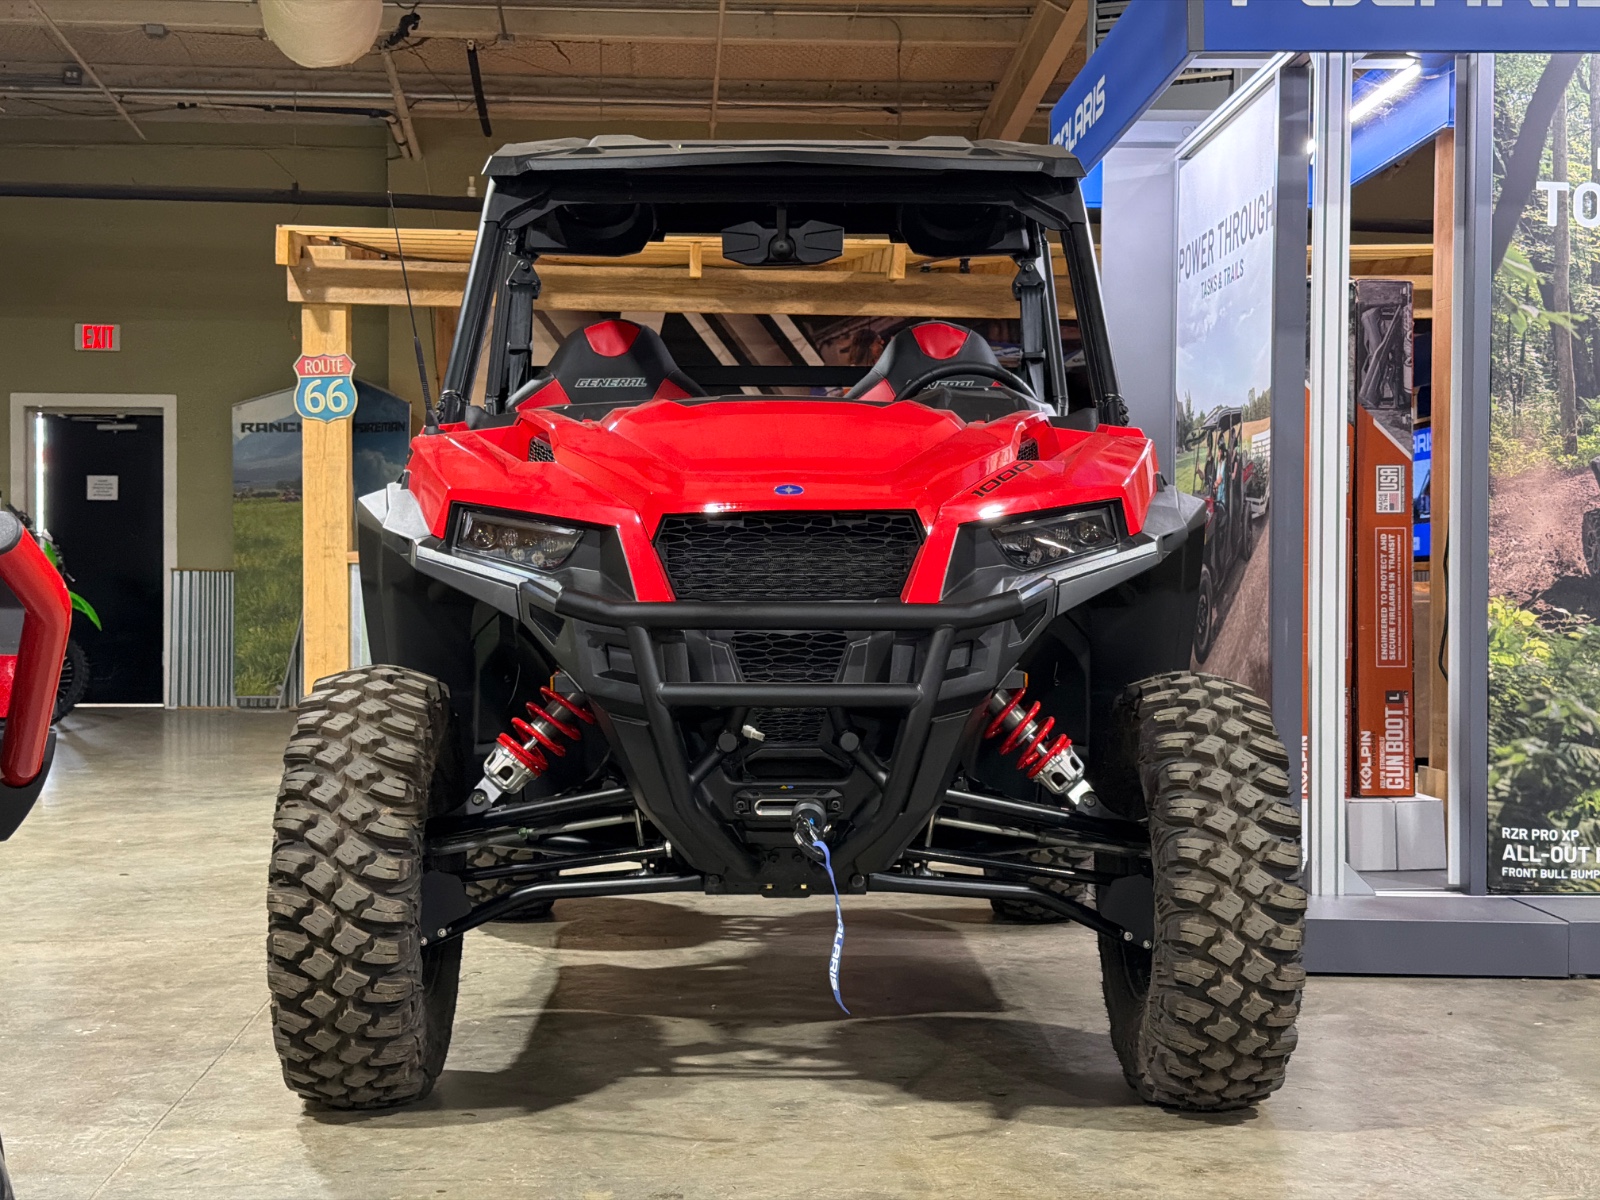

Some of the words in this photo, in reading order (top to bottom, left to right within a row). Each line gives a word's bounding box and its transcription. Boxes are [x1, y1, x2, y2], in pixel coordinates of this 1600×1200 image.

[1536, 181, 1600, 228] TO
[1178, 228, 1215, 284] POWER
[1217, 185, 1275, 260] THROUGH
[1201, 274, 1218, 299] TASKS
[1218, 271, 1223, 290] &
[1223, 258, 1244, 287] TRAILS
[82, 324, 114, 349] EXIT
[304, 359, 344, 374] ROUTE
[304, 378, 348, 413] 66
[574, 377, 647, 388] GENERAL
[971, 461, 1033, 497] 1000
[1380, 469, 1398, 490] USA
[1388, 573, 1395, 583] IN
[1380, 594, 1388, 606] TO
[1388, 584, 1396, 628] FIREARMS
[1380, 608, 1388, 660] ENGINEERED
[1388, 632, 1396, 660] SECURE
[1388, 692, 1400, 701] L
[1385, 706, 1404, 753] BOOT
[1360, 730, 1372, 790] KOLPIN
[1385, 755, 1405, 790] GUN
[1501, 827, 1529, 840] RZR
[1531, 828, 1559, 841] PRO
[1561, 829, 1580, 842] XP
[1502, 843, 1591, 864] ALL-OUT
[1501, 866, 1538, 879] FRONT
[1540, 869, 1569, 879] BULL
